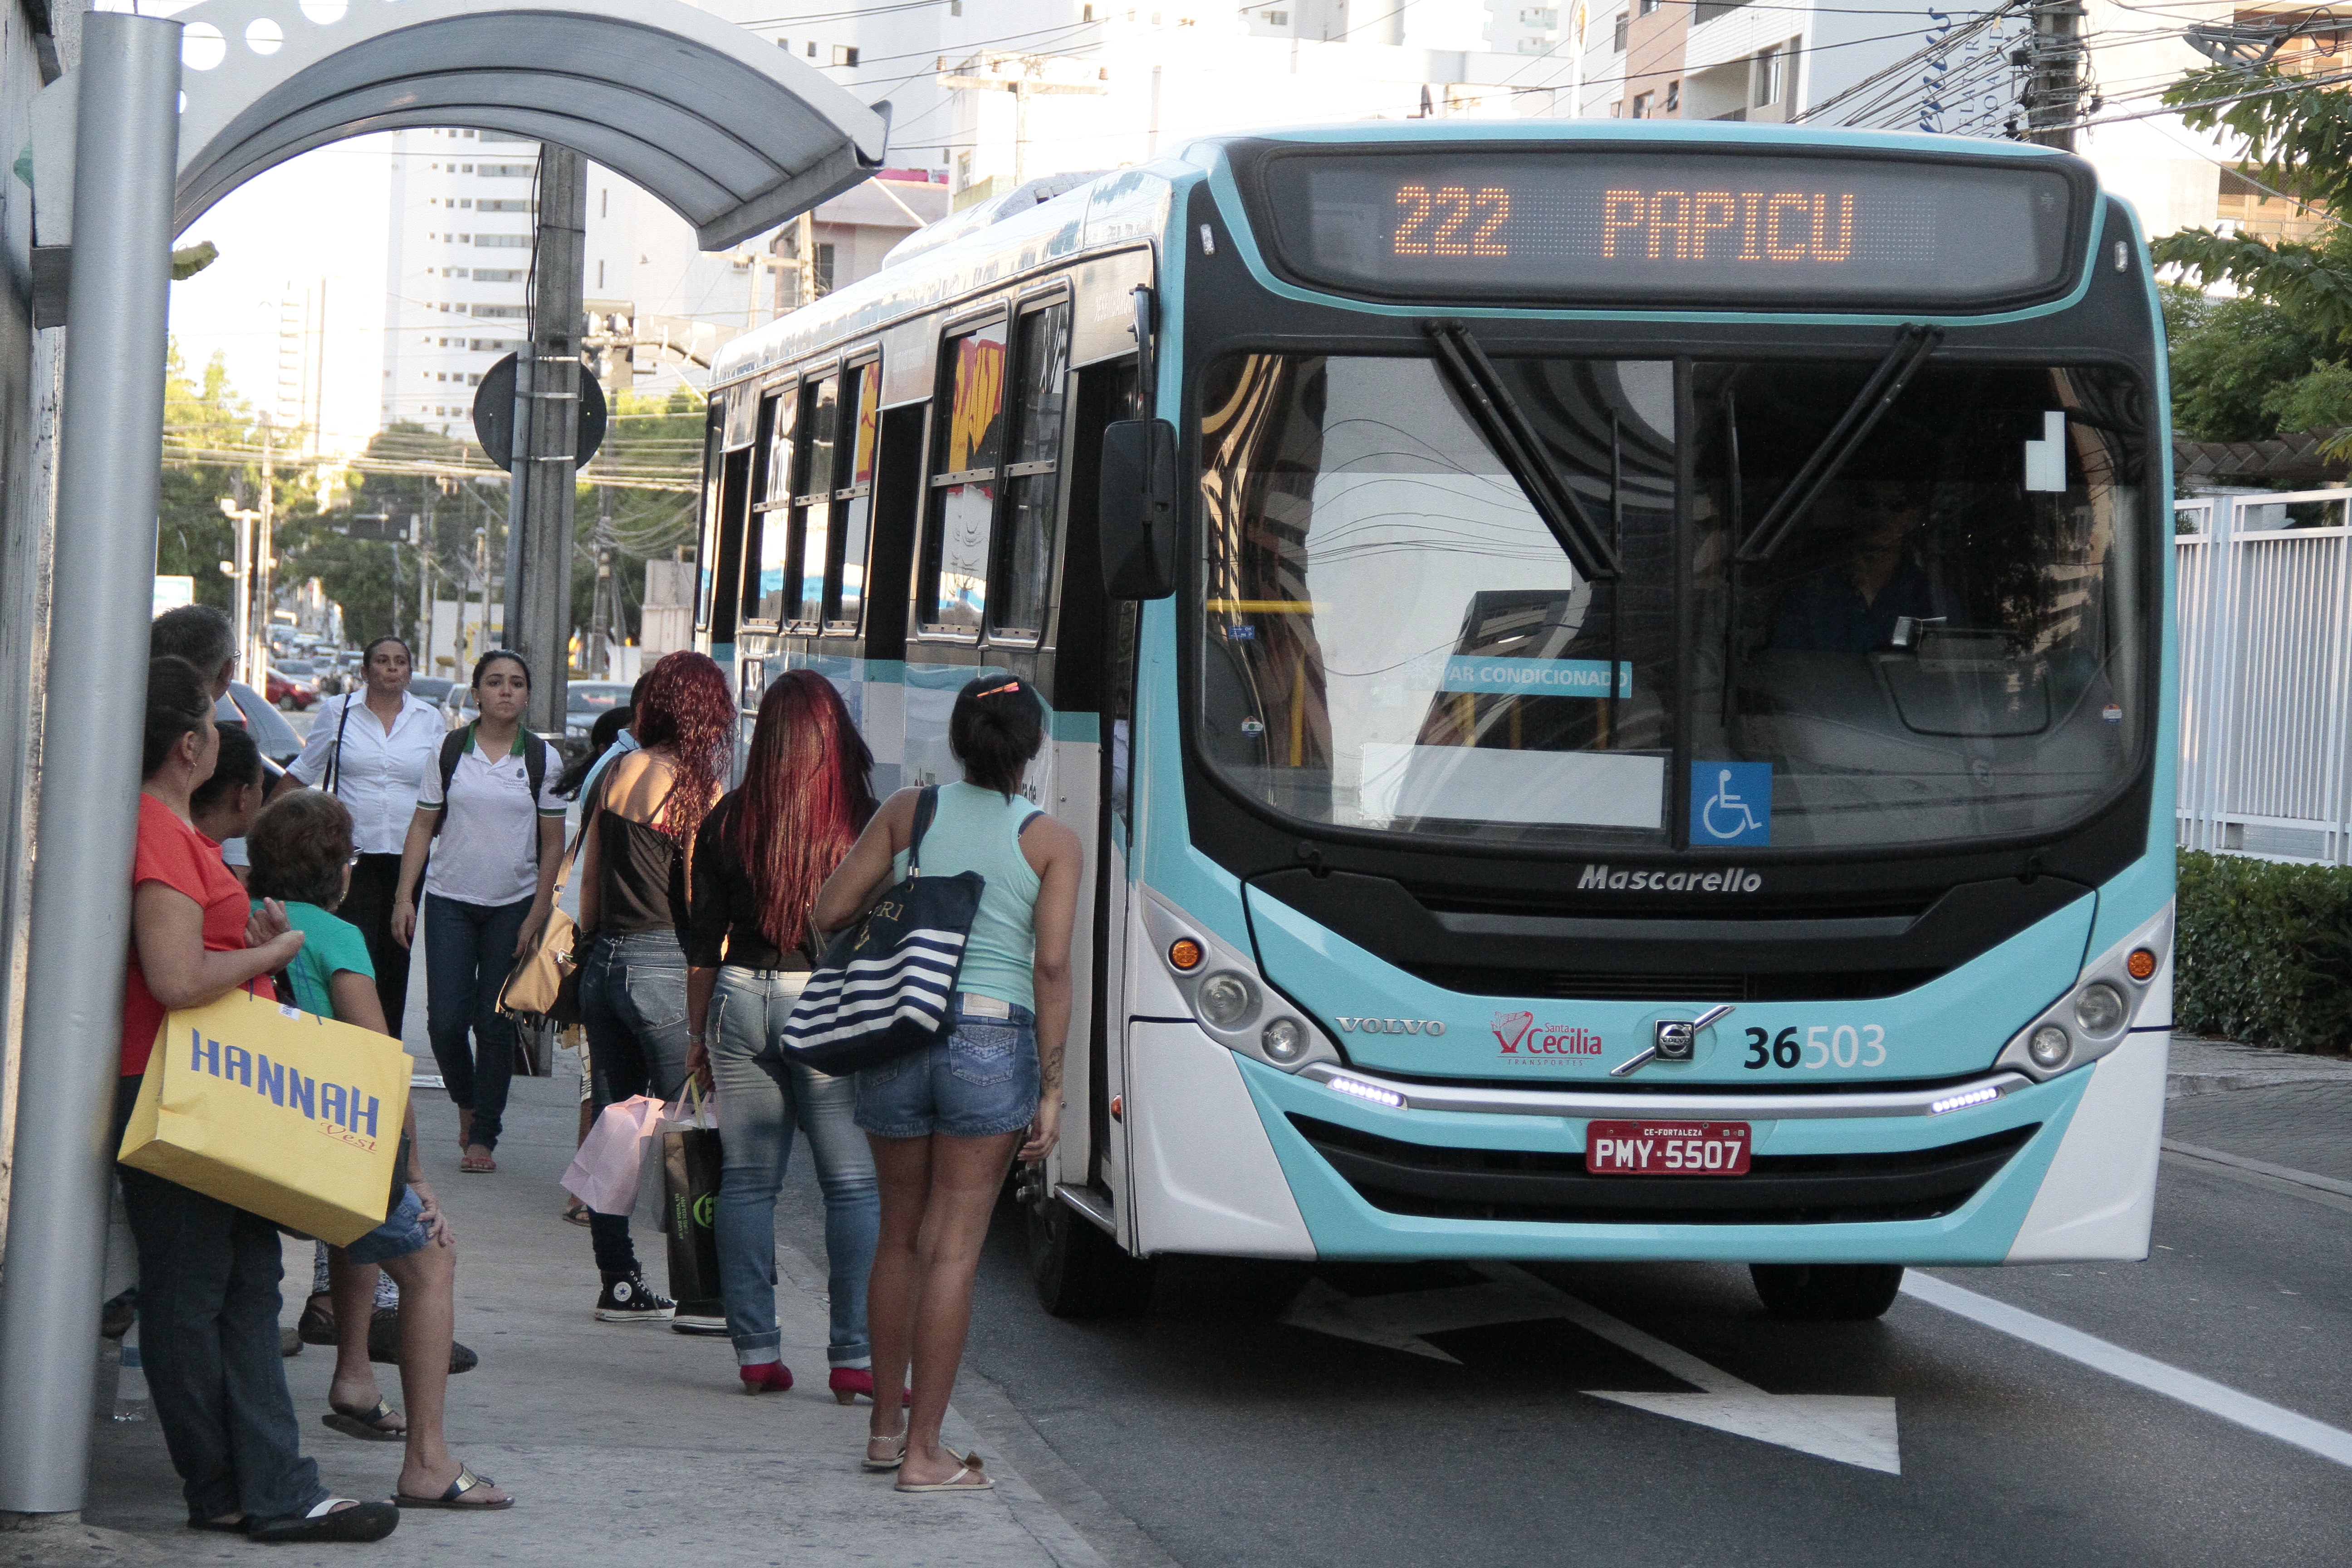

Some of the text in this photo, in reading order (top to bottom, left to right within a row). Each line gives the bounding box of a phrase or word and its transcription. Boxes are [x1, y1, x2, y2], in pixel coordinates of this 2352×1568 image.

[1956, 10, 1981, 135] ELATÓRO
[1394, 186, 1854, 261] 222 PAPICU
[1448, 666, 1628, 687] AR CONDICIONADO
[1577, 864, 1762, 892] Mascarello
[1335, 1017, 1446, 1035] VOLVO
[1545, 1022, 1569, 1033] Santa
[1527, 1028, 1602, 1055] Cecilia
[1744, 1024, 1886, 1069] 36503
[191, 1028, 379, 1138] HANNAH
[320, 1122, 377, 1152] Vest
